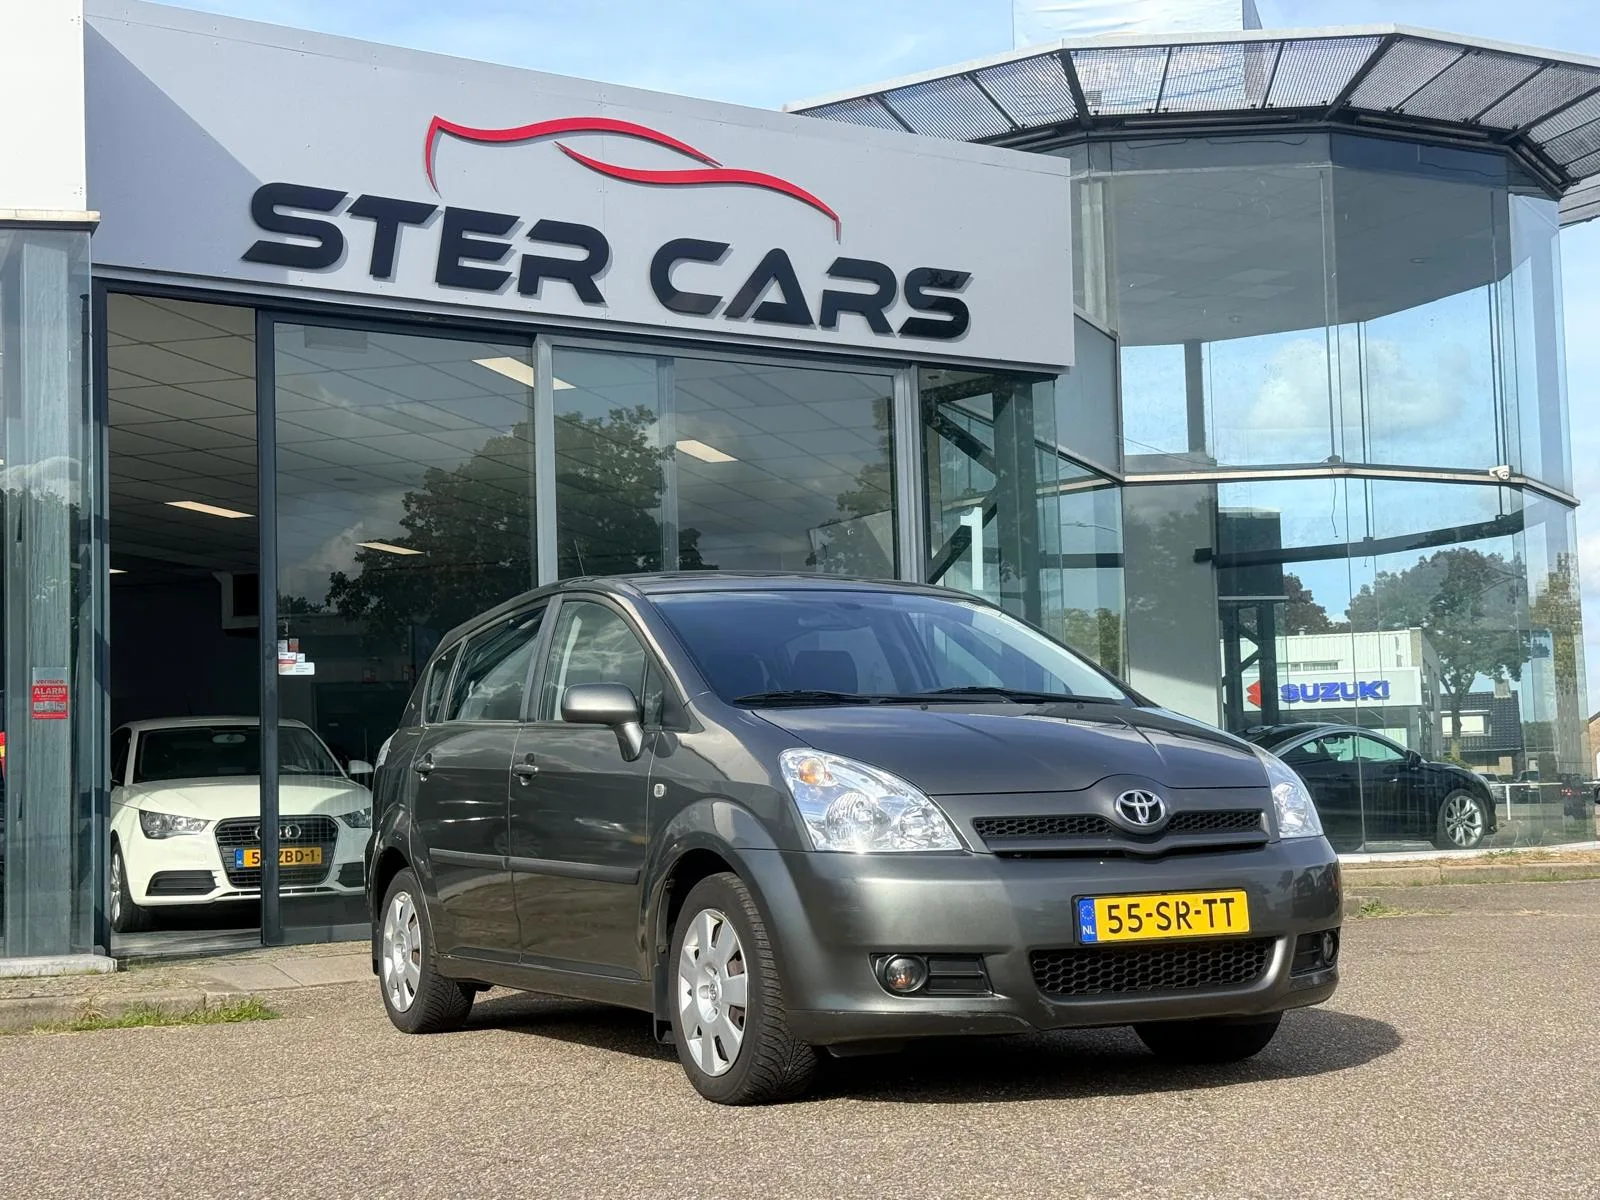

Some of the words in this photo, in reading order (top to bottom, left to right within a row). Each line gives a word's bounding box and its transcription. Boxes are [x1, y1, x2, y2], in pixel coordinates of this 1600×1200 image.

[241, 182, 608, 305] STER
[650, 238, 972, 340] CARS
[960, 506, 983, 591] 1
[34, 687, 66, 695] ALARM
[1280, 680, 1390, 703] SUZUKI
[251, 849, 316, 864] 5ZBD-1
[1107, 897, 1235, 934] 55-SR-TT
[1082, 925, 1096, 935] NL
